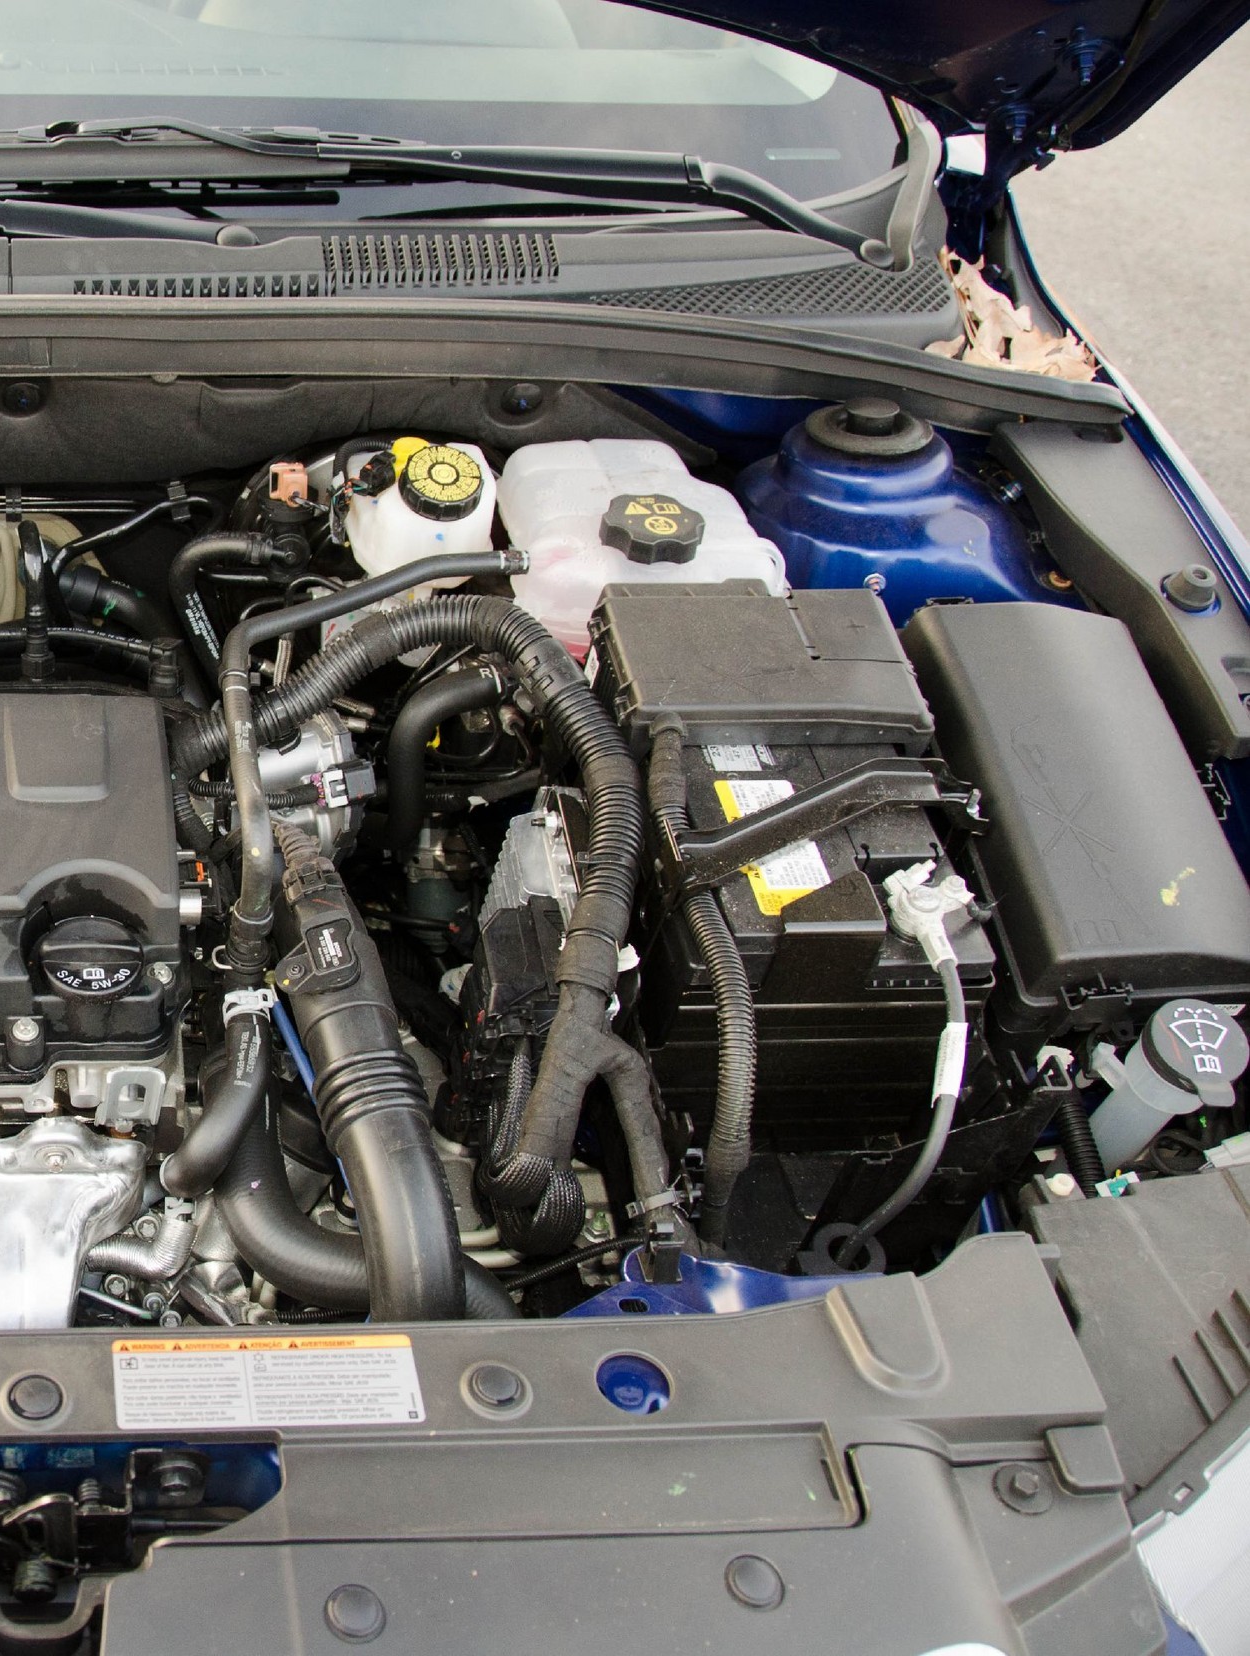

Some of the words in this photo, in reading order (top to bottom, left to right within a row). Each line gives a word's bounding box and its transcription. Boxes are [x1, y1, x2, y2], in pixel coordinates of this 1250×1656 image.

[479, 668, 493, 679] R
[56, 969, 83, 988] SAE
[91, 968, 131, 990] 5W-30
[131, 1343, 165, 1351] WARNING
